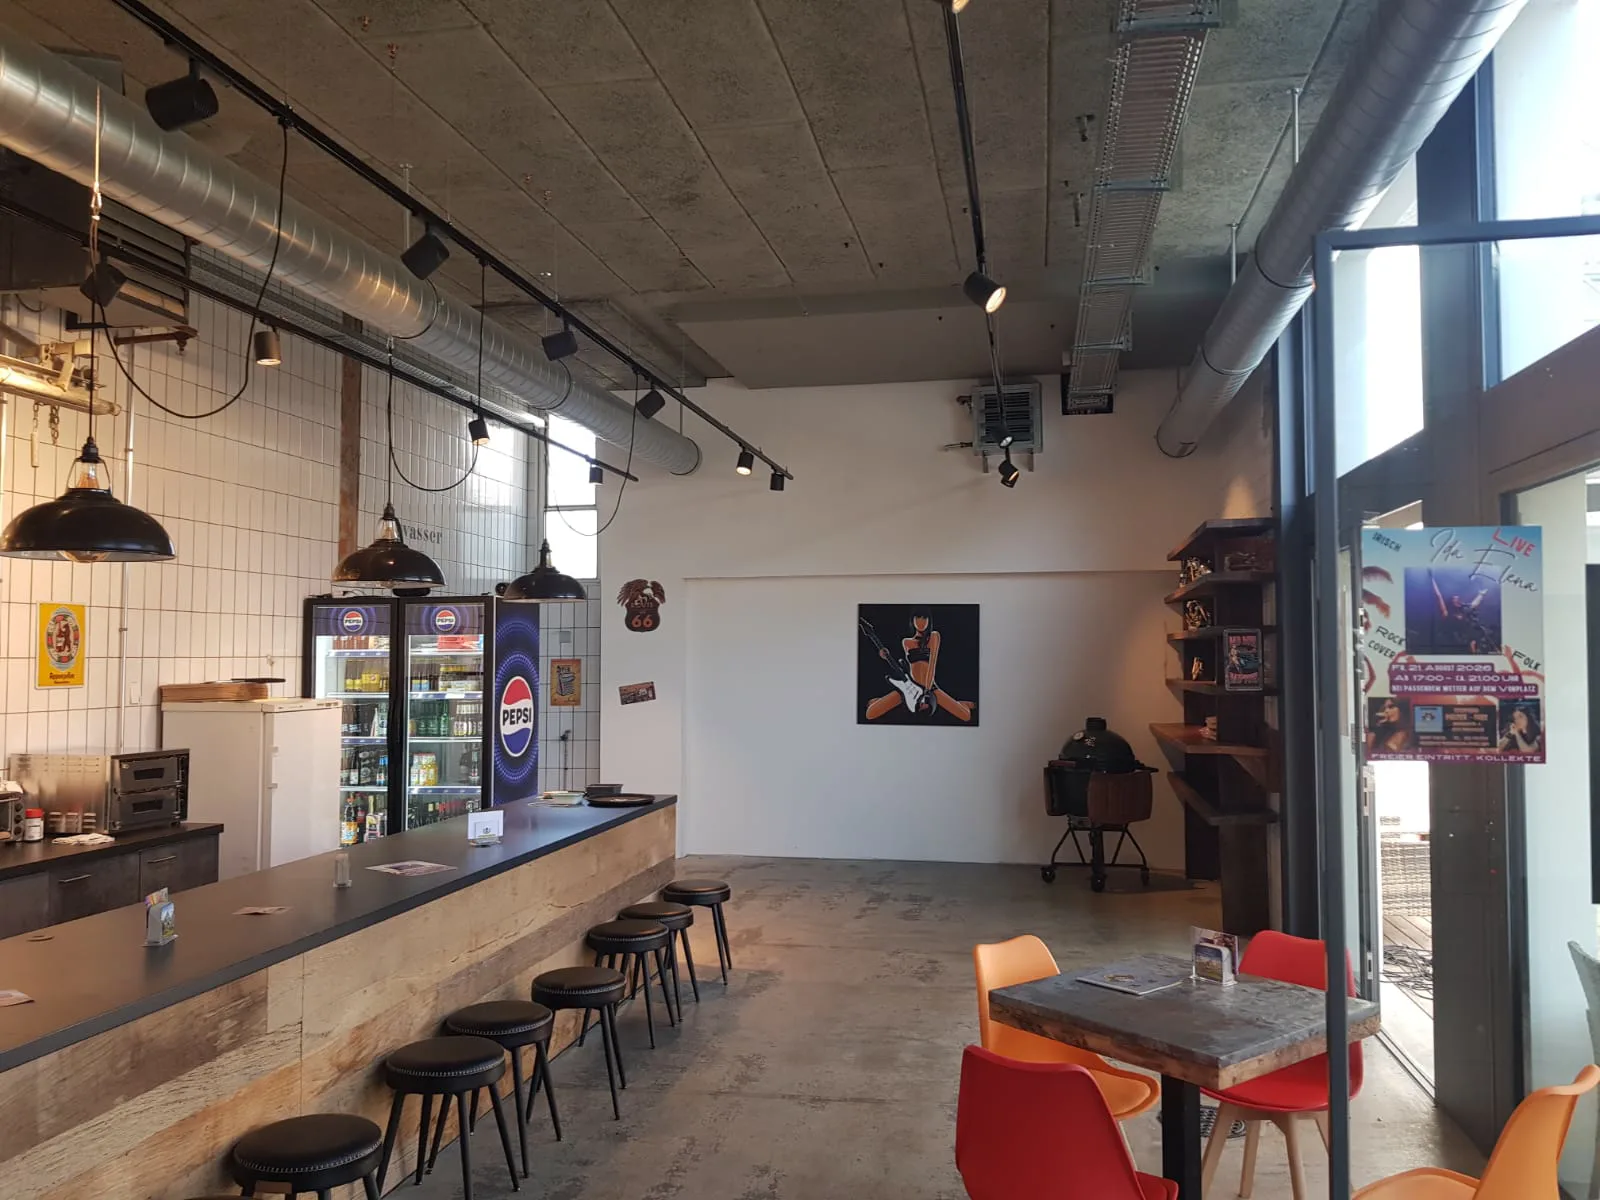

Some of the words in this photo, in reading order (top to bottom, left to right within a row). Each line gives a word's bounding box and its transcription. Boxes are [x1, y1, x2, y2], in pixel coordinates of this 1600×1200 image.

[1372, 531, 1402, 552] IRISCH
[1492, 527, 1536, 557] LIVE
[1468, 544, 1538, 592] Elena
[631, 614, 653, 628] 66
[1376, 625, 1406, 646] ROCK
[1368, 640, 1396, 658] COVER
[1511, 649, 1542, 671] FOLK
[502, 707, 532, 726] PEPSI
